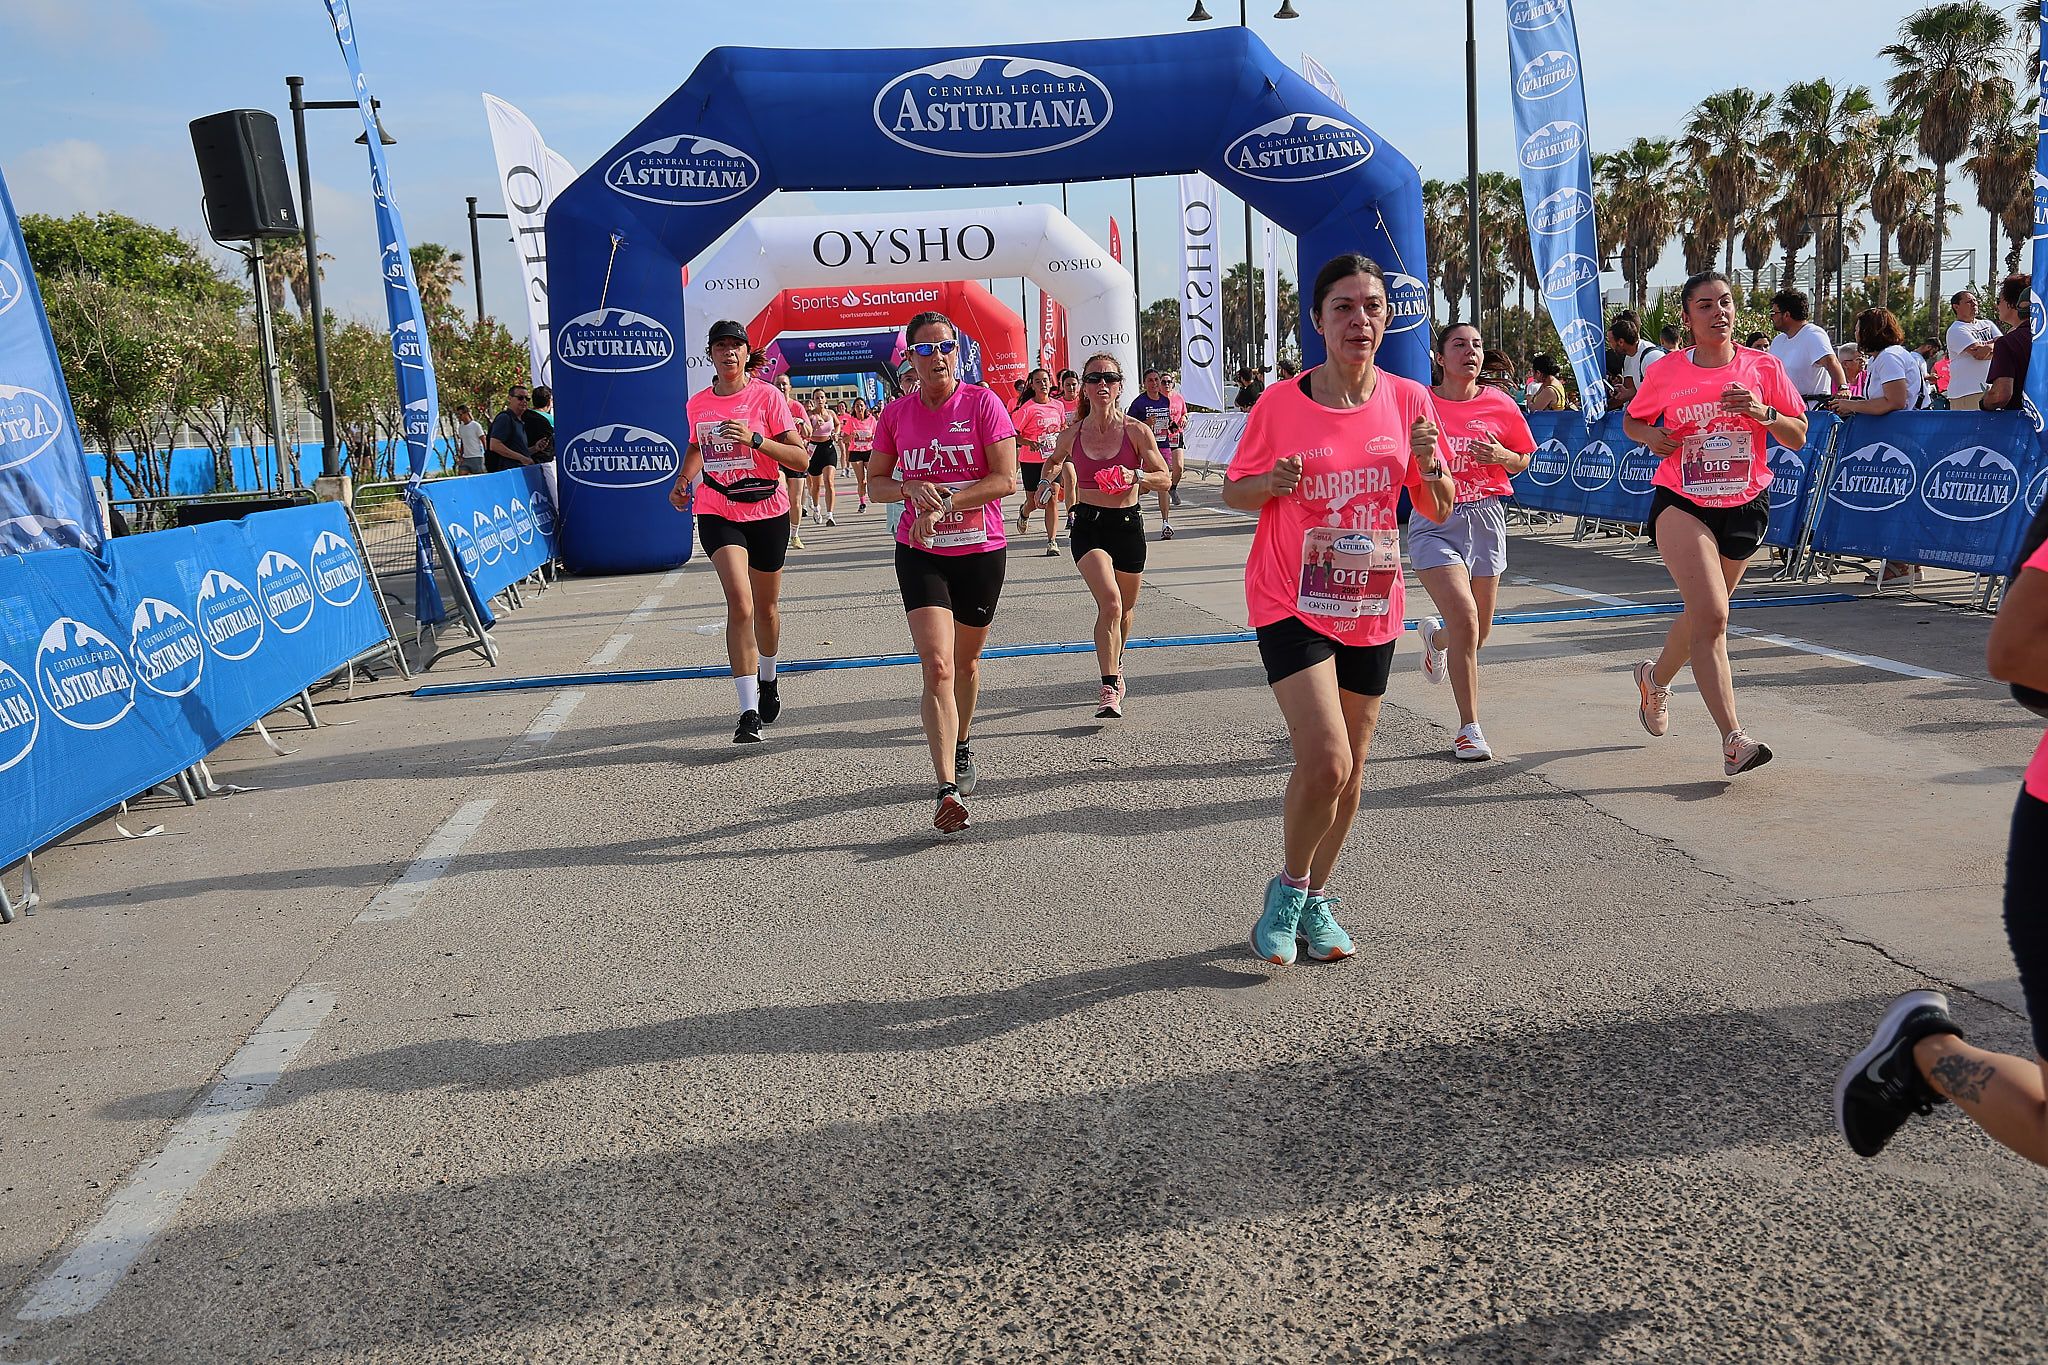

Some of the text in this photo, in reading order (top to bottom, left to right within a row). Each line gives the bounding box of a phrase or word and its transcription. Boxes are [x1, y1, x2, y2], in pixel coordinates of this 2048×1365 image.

[929, 82, 1087, 97] CENTRAL LECHERA
[893, 89, 1096, 132] ASTURIANA
[1259, 131, 1357, 149] CENTRAL LECHERA
[1237, 140, 1368, 169] ASTURIANA
[640, 158, 746, 168] CENTRAL LECHERA
[614, 161, 748, 188] ASTURIANA
[813, 224, 995, 268] OYSHO
[1048, 257, 1102, 273] OYSHO
[704, 277, 761, 291] OYSHO
[791, 288, 939, 312] Sports Santander
[839, 310, 890, 319] sportssantander.es
[577, 330, 664, 338] CENTRAL LECHERA
[1080, 332, 1130, 348] OYSHO
[562, 333, 668, 358] ASTURIANA
[817, 340, 869, 349] octopus energy
[686, 356, 714, 369] OYS
[996, 352, 1018, 360] Sports
[995, 362, 1026, 371] Santander
[1670, 387, 1698, 400] OYSHO
[583, 445, 669, 453] CENTRAL LECHERA
[714, 443, 734, 452] 016
[569, 448, 673, 472] ASTURIANA
[1529, 455, 1566, 475] ASTURIANA
[1704, 460, 1731, 472] 016
[1573, 457, 1611, 479] ASTURIANA
[1945, 470, 2012, 481] CENTRAL LECHERA
[1829, 467, 1907, 496] ASTURIANA
[1926, 471, 2010, 505] ASTURIANA
[1333, 569, 1368, 585] 016
[1308, 601, 1340, 611] OYSHO
[205, 604, 261, 646] ASTURIANA
[1333, 620, 1356, 633] 2026
